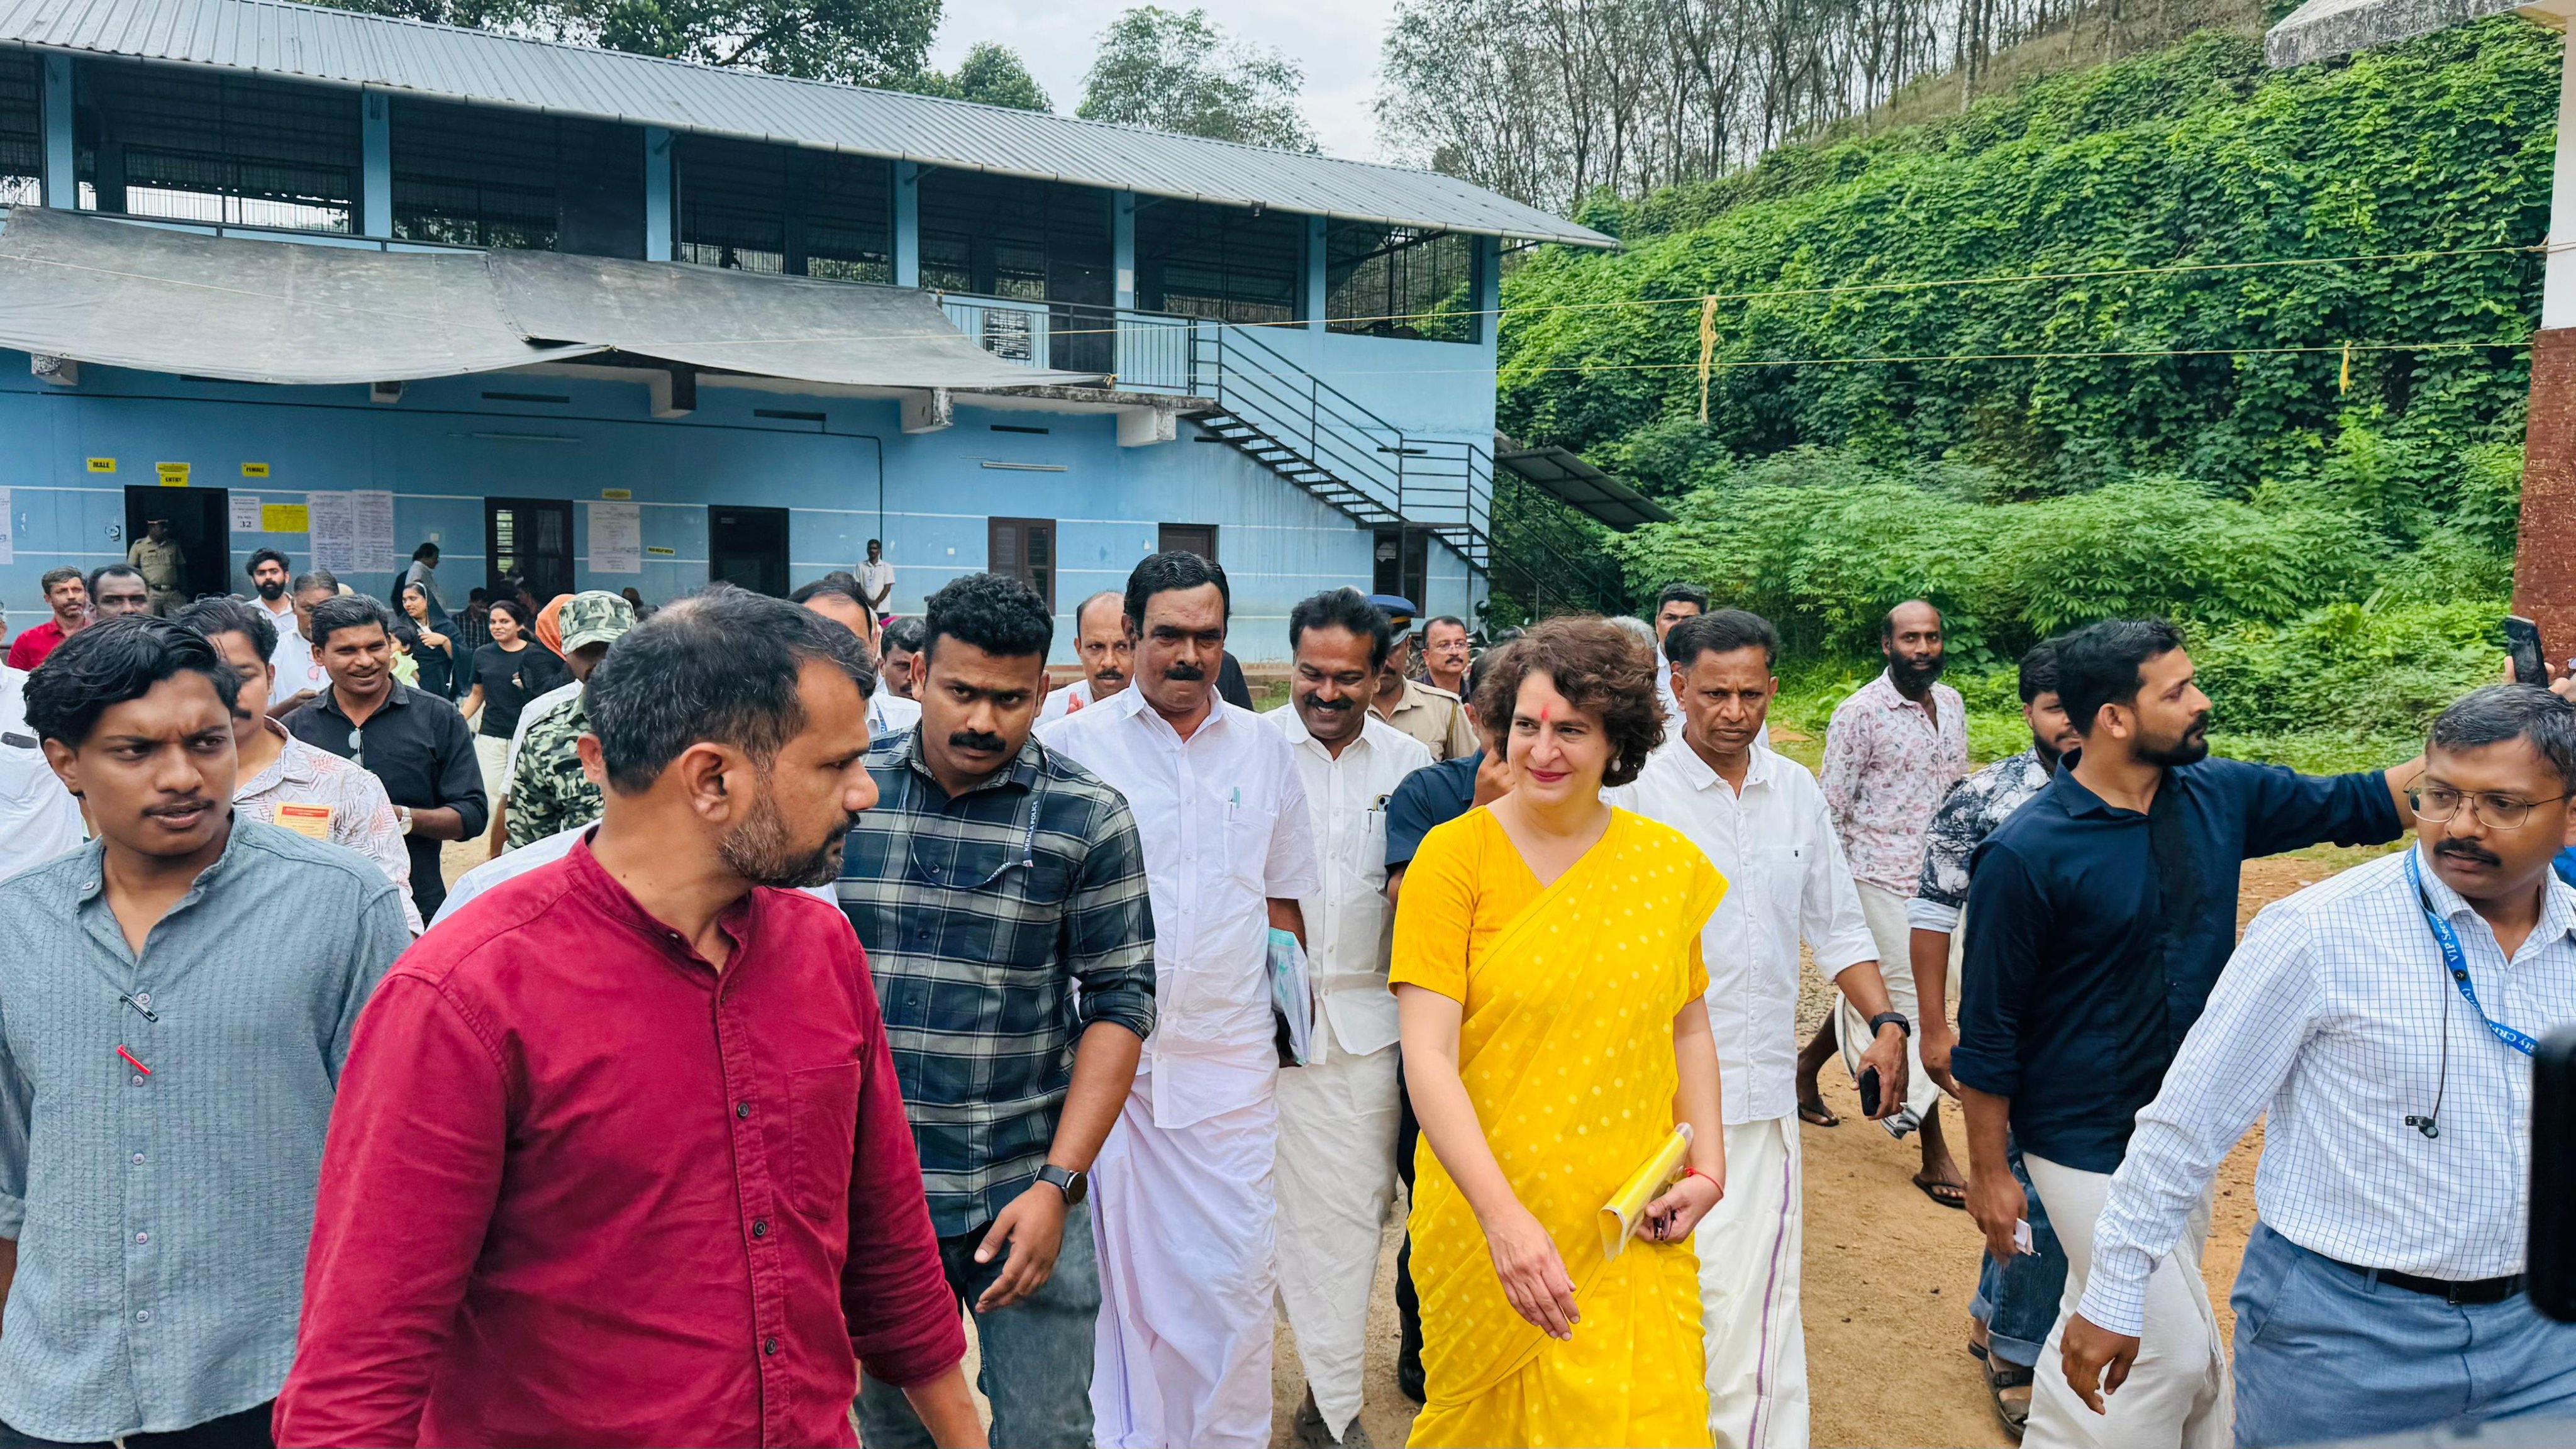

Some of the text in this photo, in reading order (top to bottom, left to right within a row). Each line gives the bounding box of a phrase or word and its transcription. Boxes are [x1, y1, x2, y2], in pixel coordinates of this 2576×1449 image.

[1023, 800, 1038, 852] KERALA POLICE
[2444, 943, 2459, 962] VIP
